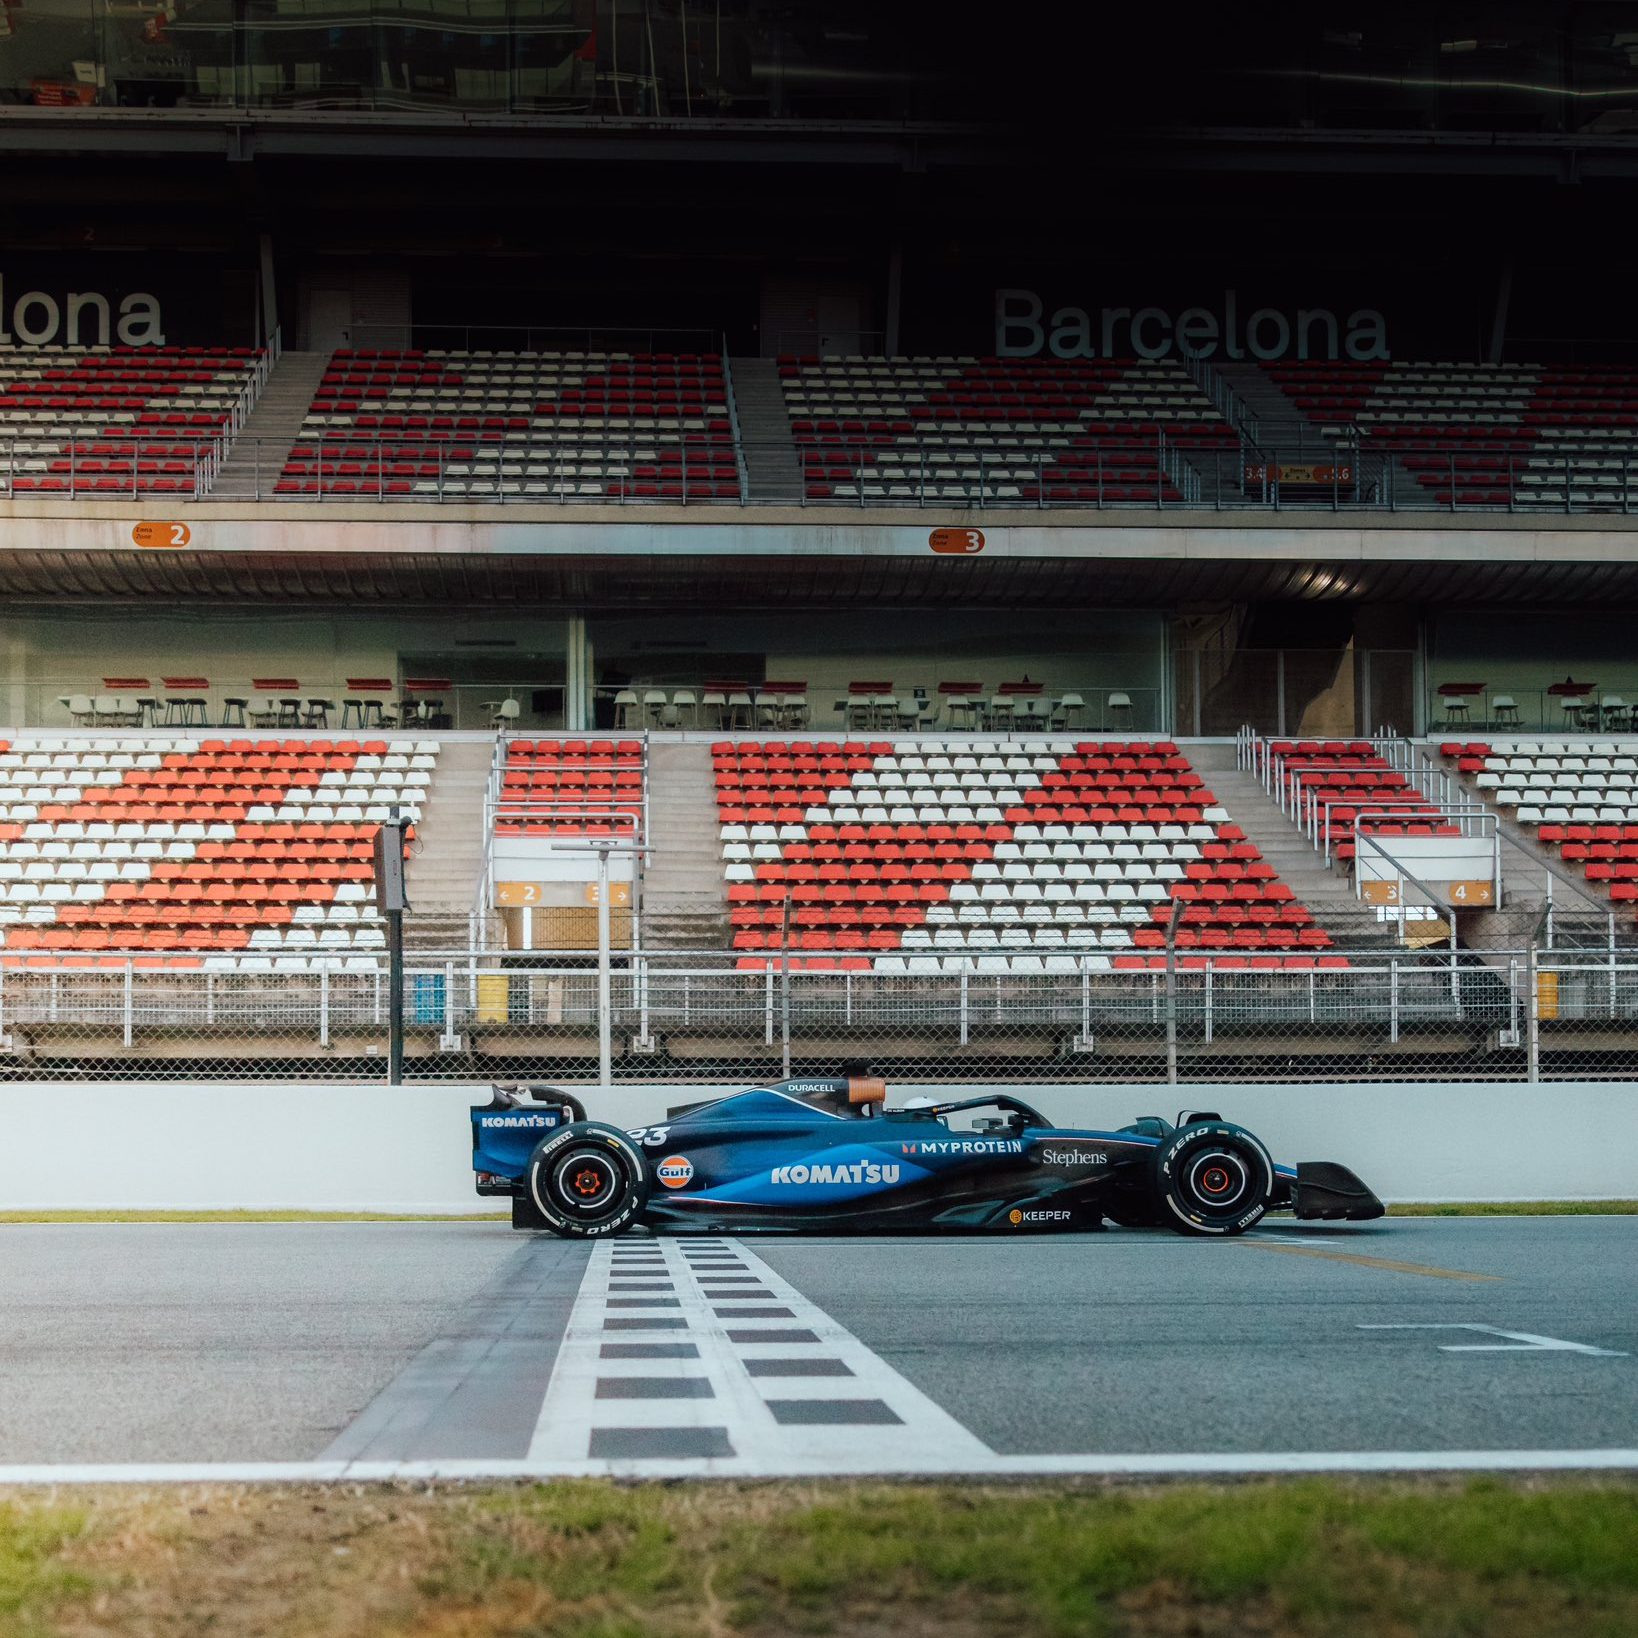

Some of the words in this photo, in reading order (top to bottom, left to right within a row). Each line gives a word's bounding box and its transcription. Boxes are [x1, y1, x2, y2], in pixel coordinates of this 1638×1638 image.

[995, 288, 1390, 360] Barcelona
[170, 525, 185, 545] 2
[966, 532, 980, 551] 3
[523, 886, 535, 900] 2
[1387, 885, 1397, 900] 3
[1455, 885, 1466, 900] 4
[788, 1084, 836, 1093] DURACELL
[481, 1115, 556, 1128] KOMATSU
[921, 1140, 1022, 1154] MYPROTEIN
[1168, 1127, 1209, 1160] ZERO
[1042, 1149, 1107, 1167] Stephens
[660, 1167, 691, 1177] Gulf
[771, 1159, 900, 1184] KOMATSU
[586, 1208, 630, 1235] ZERO
[1022, 1210, 1071, 1222] KEEPER
